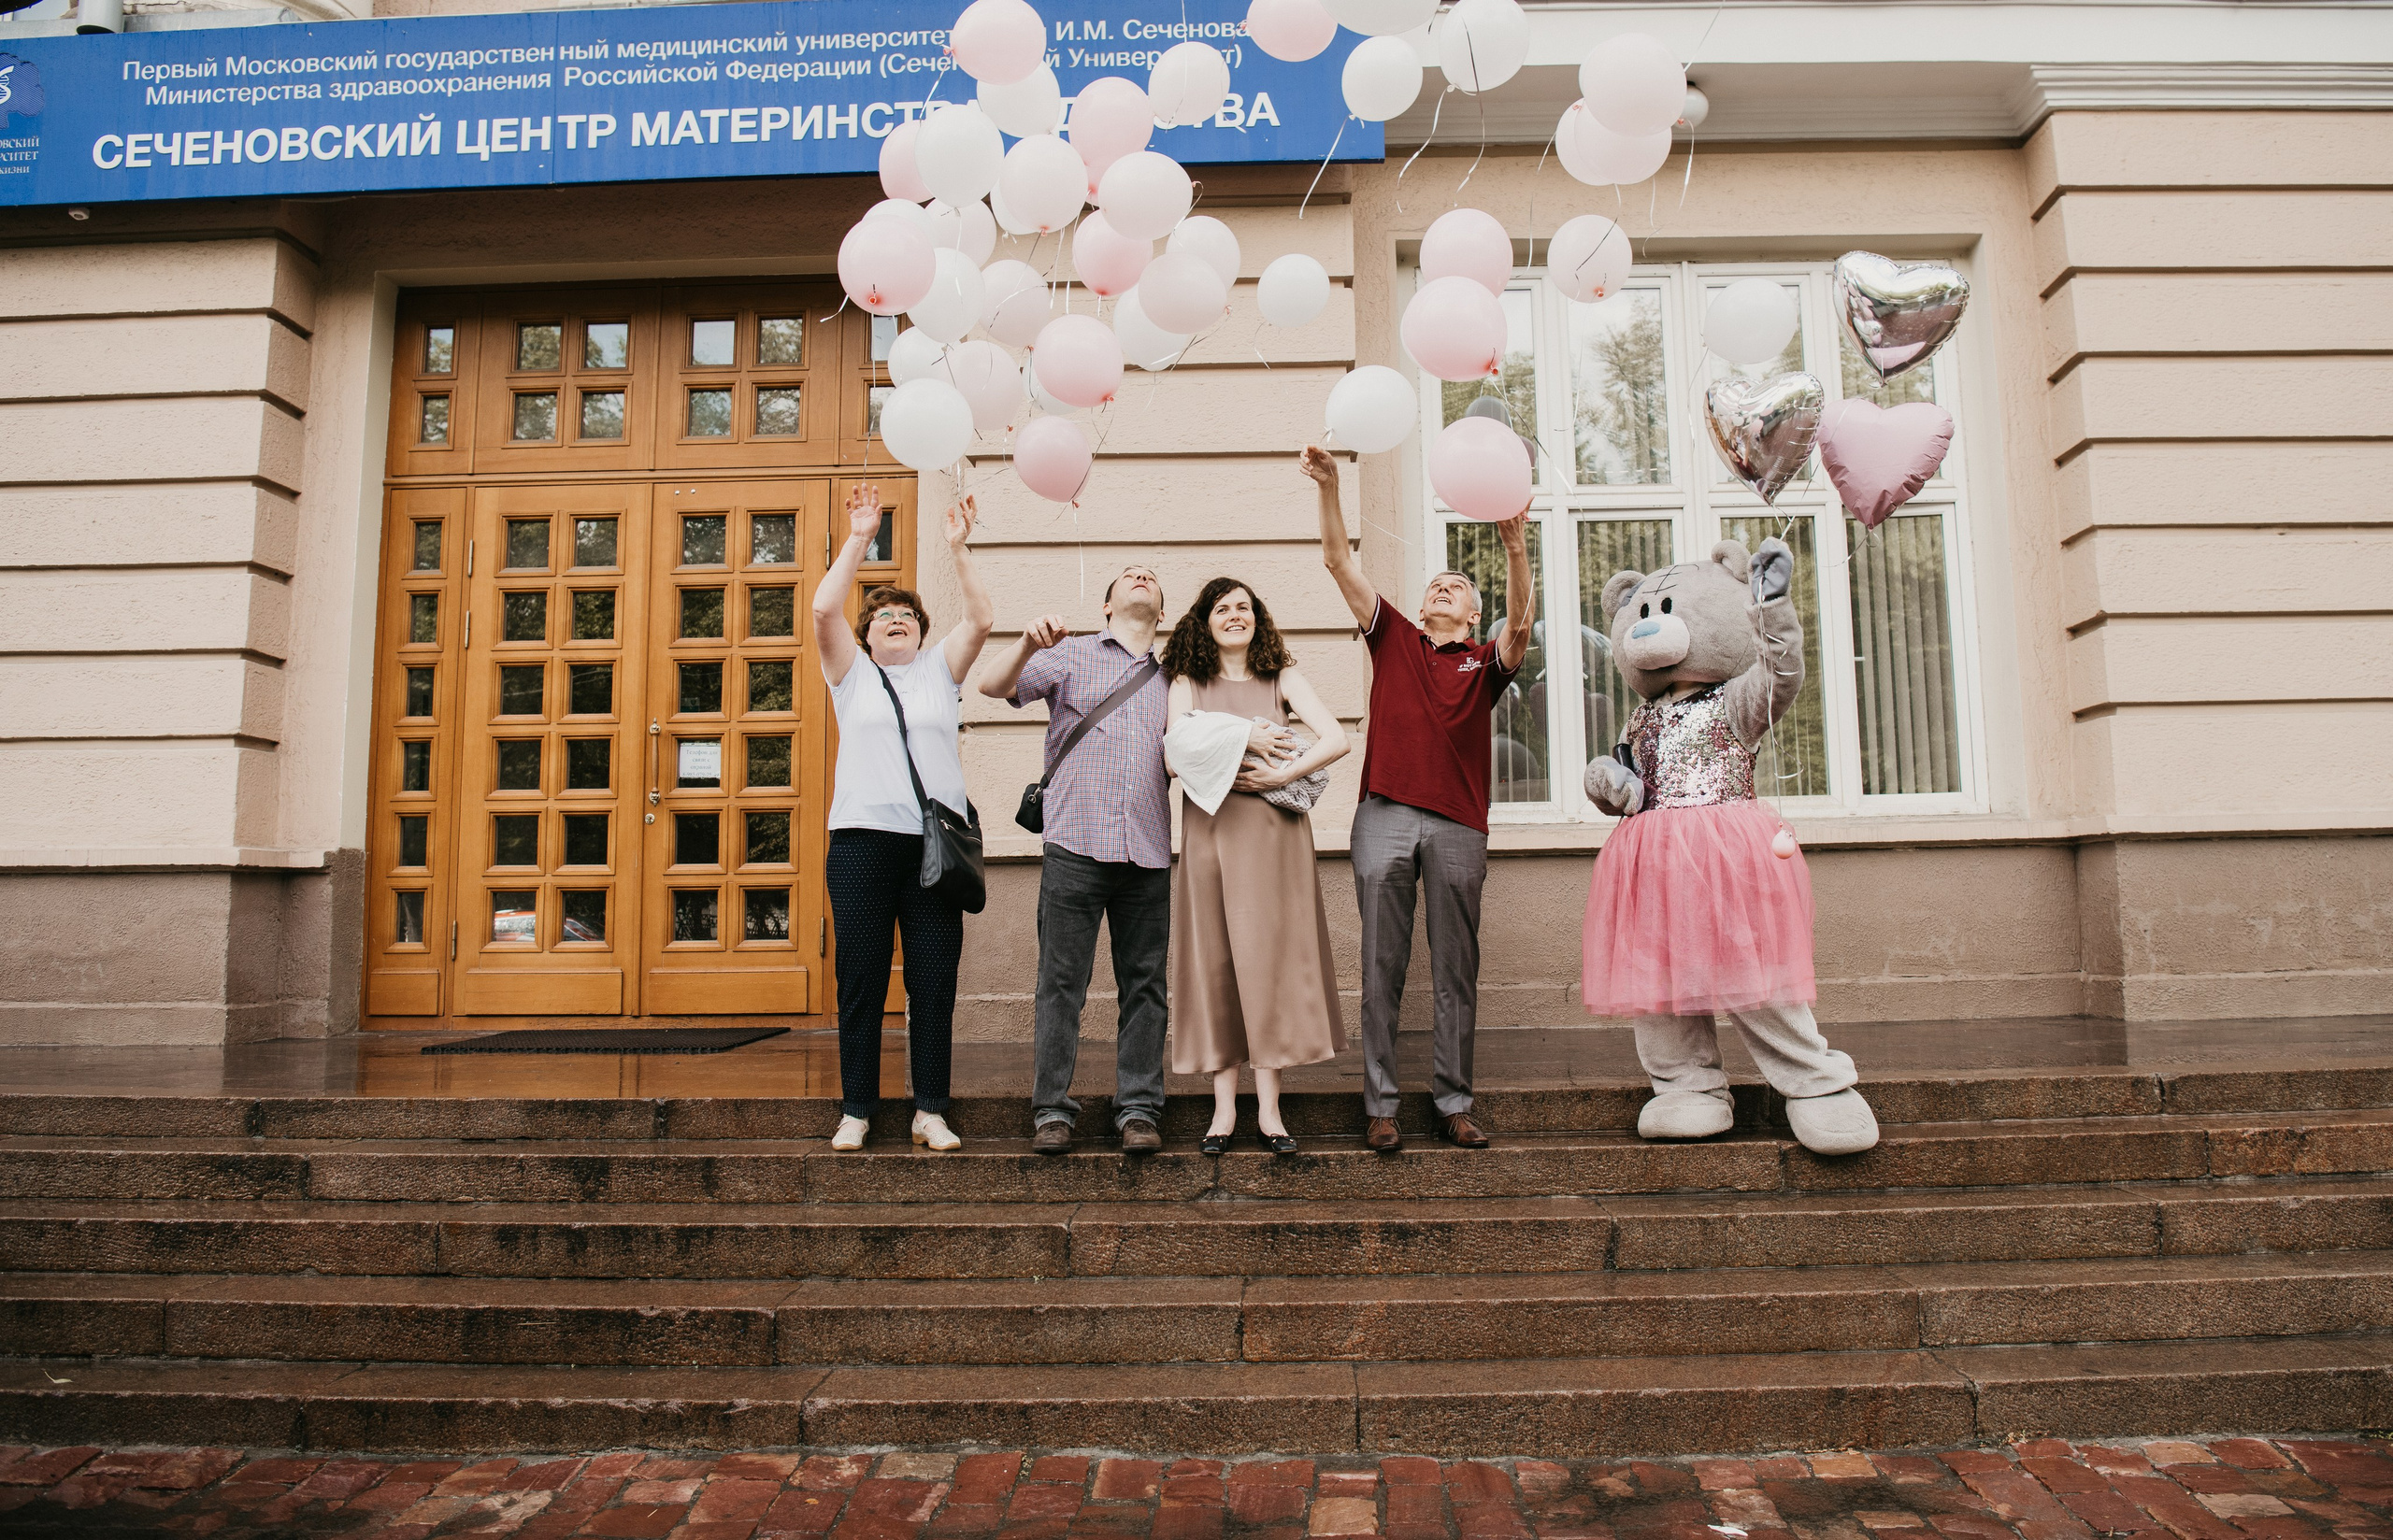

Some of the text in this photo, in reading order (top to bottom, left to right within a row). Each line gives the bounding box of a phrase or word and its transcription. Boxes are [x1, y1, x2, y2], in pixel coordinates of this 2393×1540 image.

[123, 57, 217, 83] Первый
[226, 50, 378, 77] Московский
[617, 30, 788, 61] медицинский
[1055, 20, 1114, 41] И.М.
[1123, 19, 1252, 40] Сеченова
[145, 83, 322, 106] Министерства
[329, 73, 552, 101] здравоохранения
[565, 61, 718, 86] Российской
[725, 59, 871, 83] Федерации
[93, 98, 979, 169] СЕЧЕНОВСКИЙ ЦЕНТР МАТЕРИНСТ
